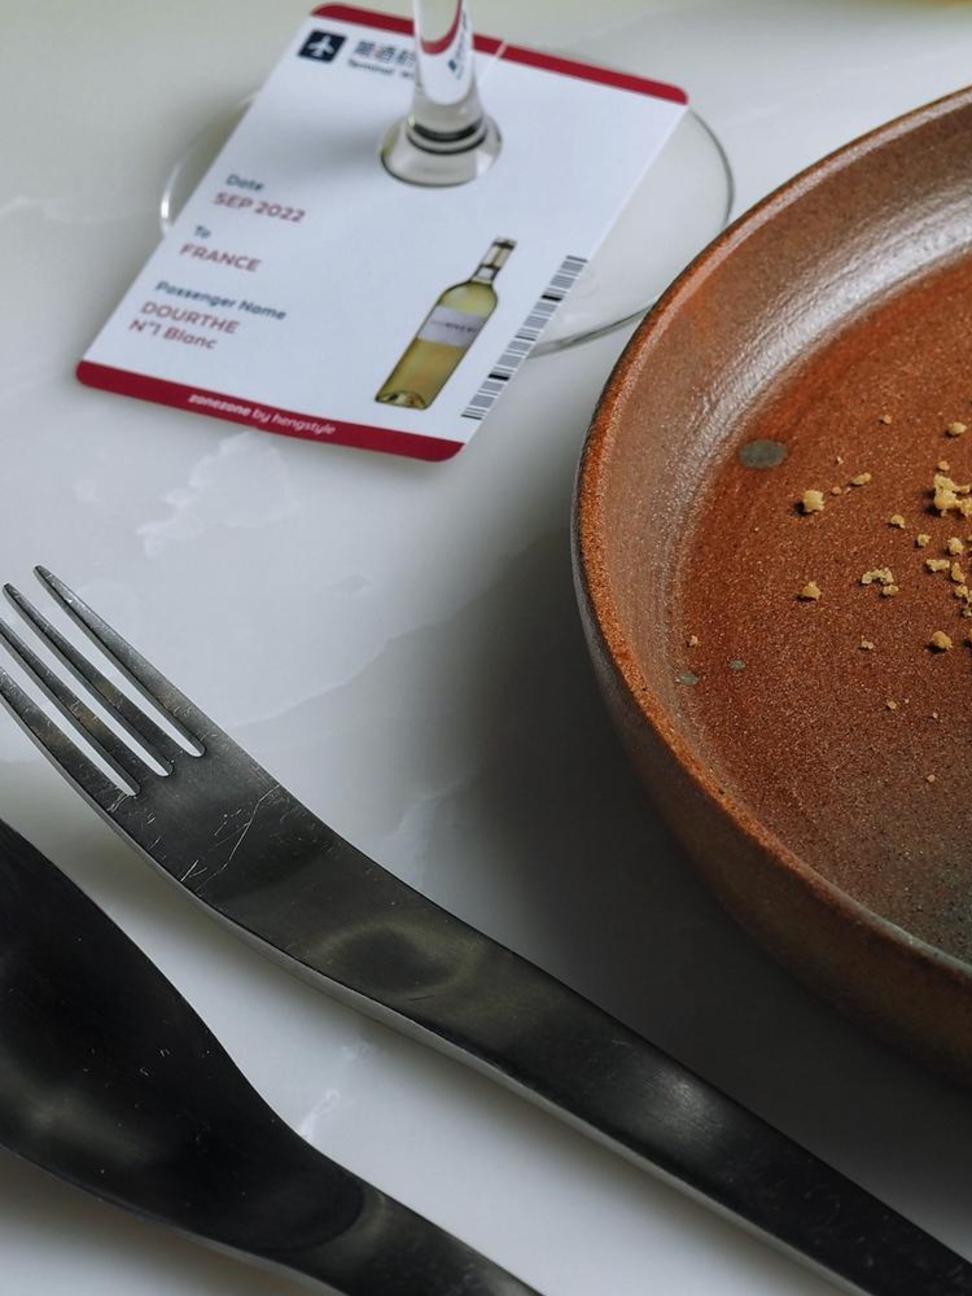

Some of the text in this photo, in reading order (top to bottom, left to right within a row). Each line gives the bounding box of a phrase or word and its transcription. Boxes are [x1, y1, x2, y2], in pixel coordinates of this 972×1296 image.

[226, 174, 264, 191] Date
[214, 192, 306, 223] SEP 2022
[194, 225, 211, 238] To
[179, 243, 262, 273] FRANCE
[155, 281, 287, 321] Passenger Name
[141, 301, 240, 334] DOURTHE
[163, 326, 218, 350] Blanc
[252, 409, 272, 423] by
